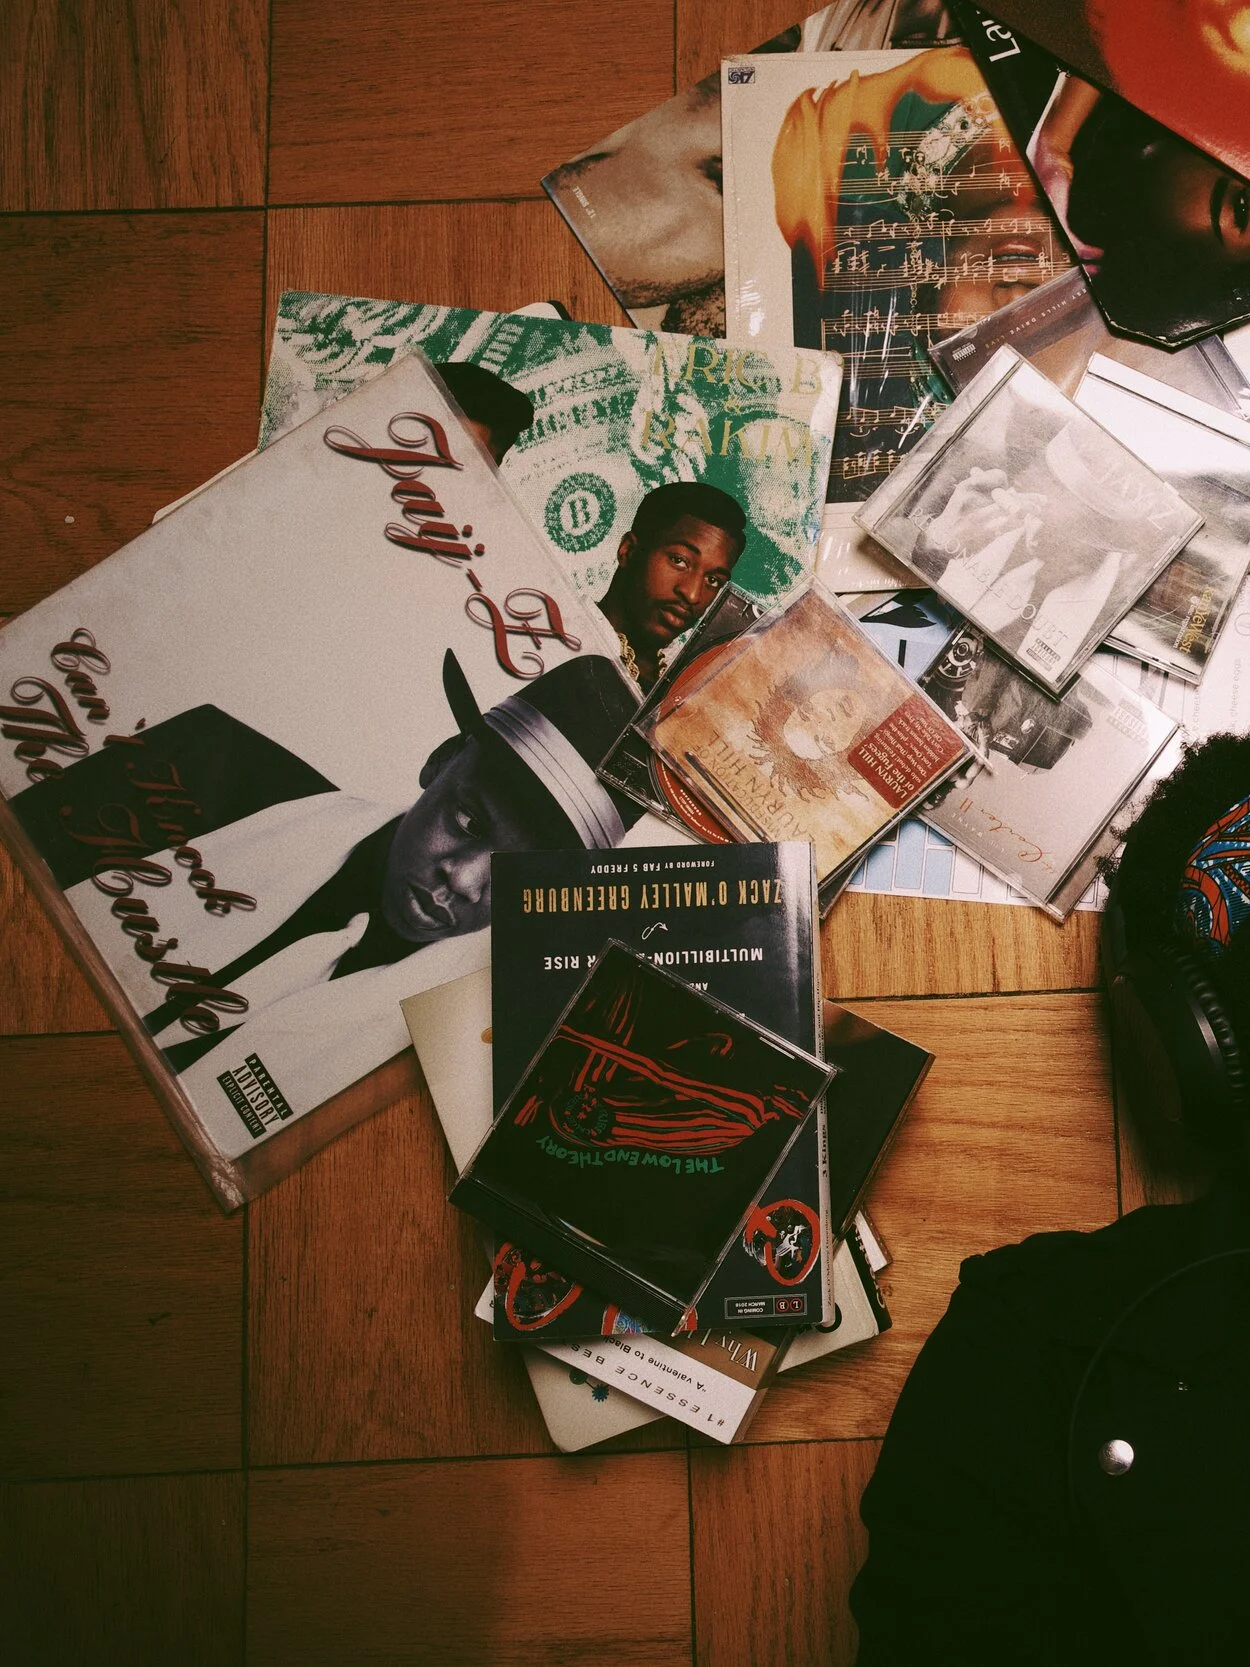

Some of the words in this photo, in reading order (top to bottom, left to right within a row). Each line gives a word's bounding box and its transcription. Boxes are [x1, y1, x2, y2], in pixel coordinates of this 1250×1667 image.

[1009, 317, 1037, 335] DRIVE
[652, 341, 769, 389] ERIC
[640, 411, 812, 466] RAKIM
[858, 747, 877, 768] HILL
[875, 765, 908, 799] LAURYN
[892, 768, 906, 781] the
[904, 781, 915, 791] of
[590, 863, 629, 875] FREDDY
[632, 863, 639, 873] 5
[642, 861, 662, 872] FAB
[664, 861, 676, 869] BY
[677, 860, 715, 869] FOREWORD
[522, 884, 631, 914] GREENBURG
[639, 879, 729, 910] O'MALLEY
[737, 878, 783, 905] ZACK
[543, 955, 580, 970] RISE
[232, 1064, 280, 1126] ADVISORY
[249, 1058, 288, 1116] PARENTAL
[222, 1075, 245, 1105] EXPLICIT
[240, 1103, 263, 1133] CONTENT
[535, 1135, 603, 1169] THEORY
[604, 1149, 640, 1161] END
[641, 1152, 683, 1174] LOW
[685, 1157, 725, 1175] THE
[745, 1305, 764, 1314] COMING
[603, 1335, 631, 1355] Black
[716, 1338, 759, 1372] Why
[635, 1350, 648, 1361] to
[649, 1355, 693, 1385] valentine
[614, 1365, 701, 1413] ESSENCE
[706, 1412, 725, 1428] #1
